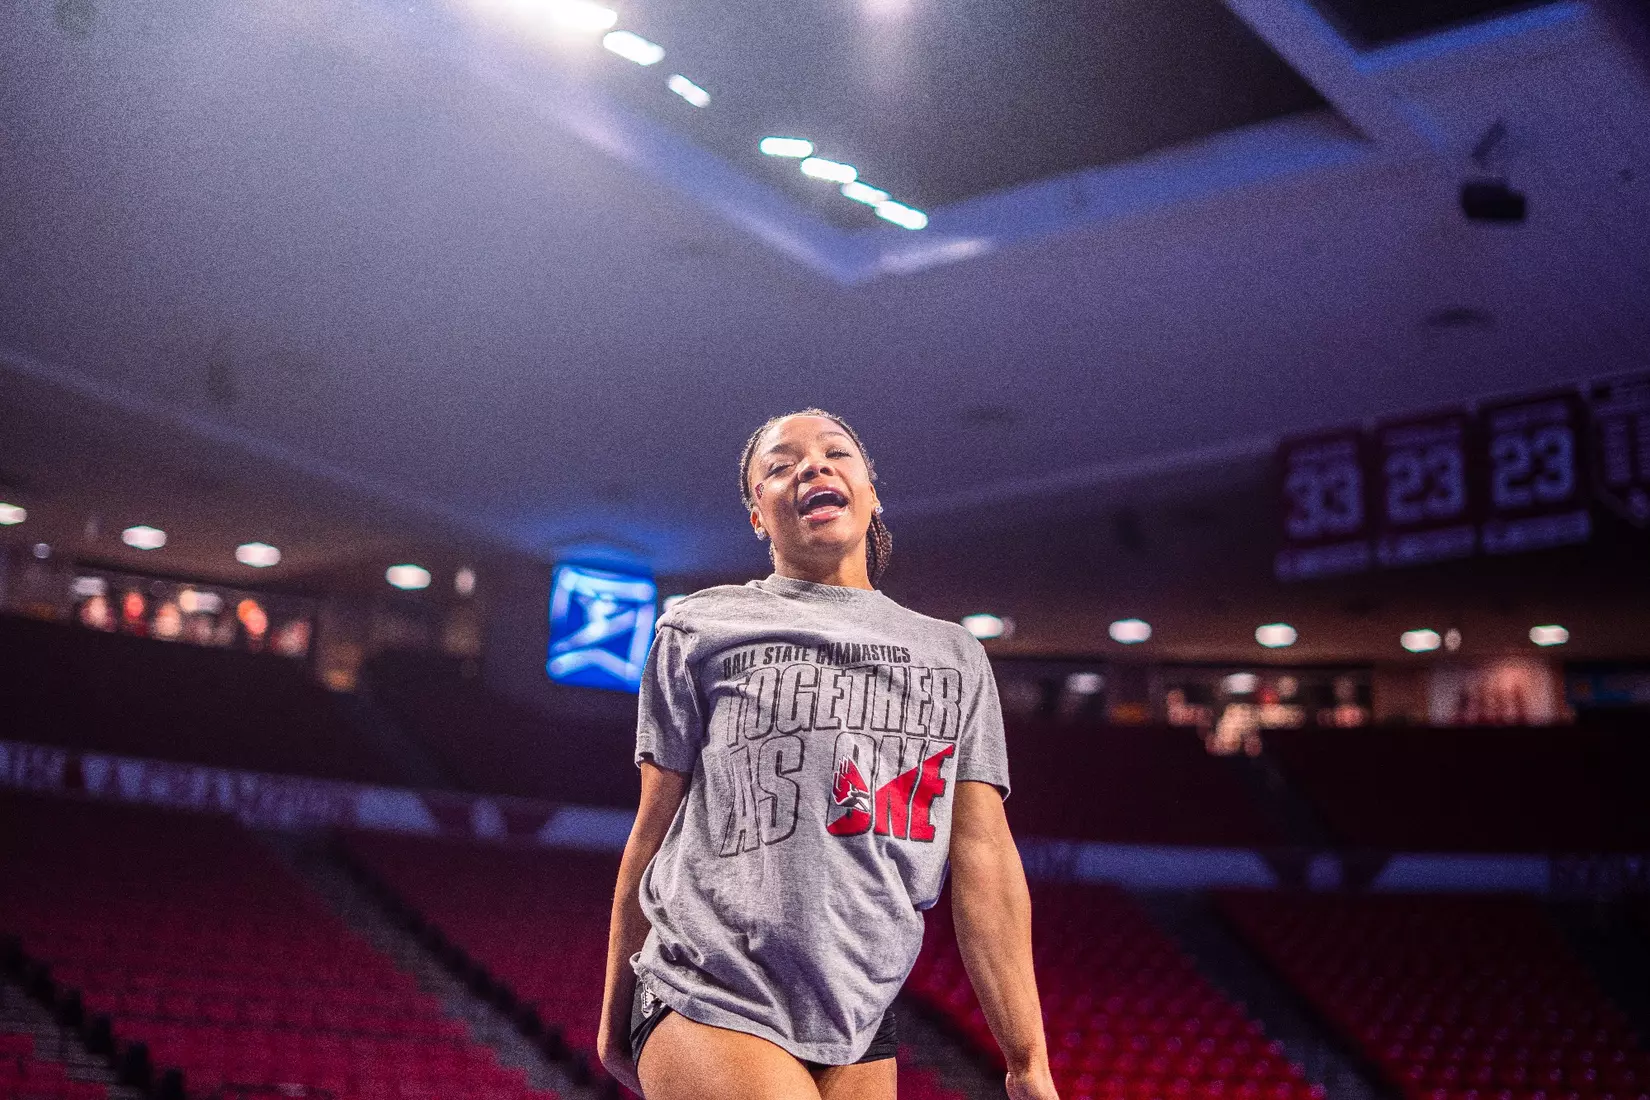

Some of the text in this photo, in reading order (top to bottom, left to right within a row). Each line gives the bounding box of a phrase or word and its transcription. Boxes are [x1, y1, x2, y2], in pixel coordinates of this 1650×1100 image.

[1384, 444, 1466, 523] 23
[1489, 426, 1576, 507] 23
[723, 641, 912, 680] BALL STATE GYMNASTICS
[724, 664, 963, 748] TOGETHER
[719, 732, 956, 858] AS ONE
